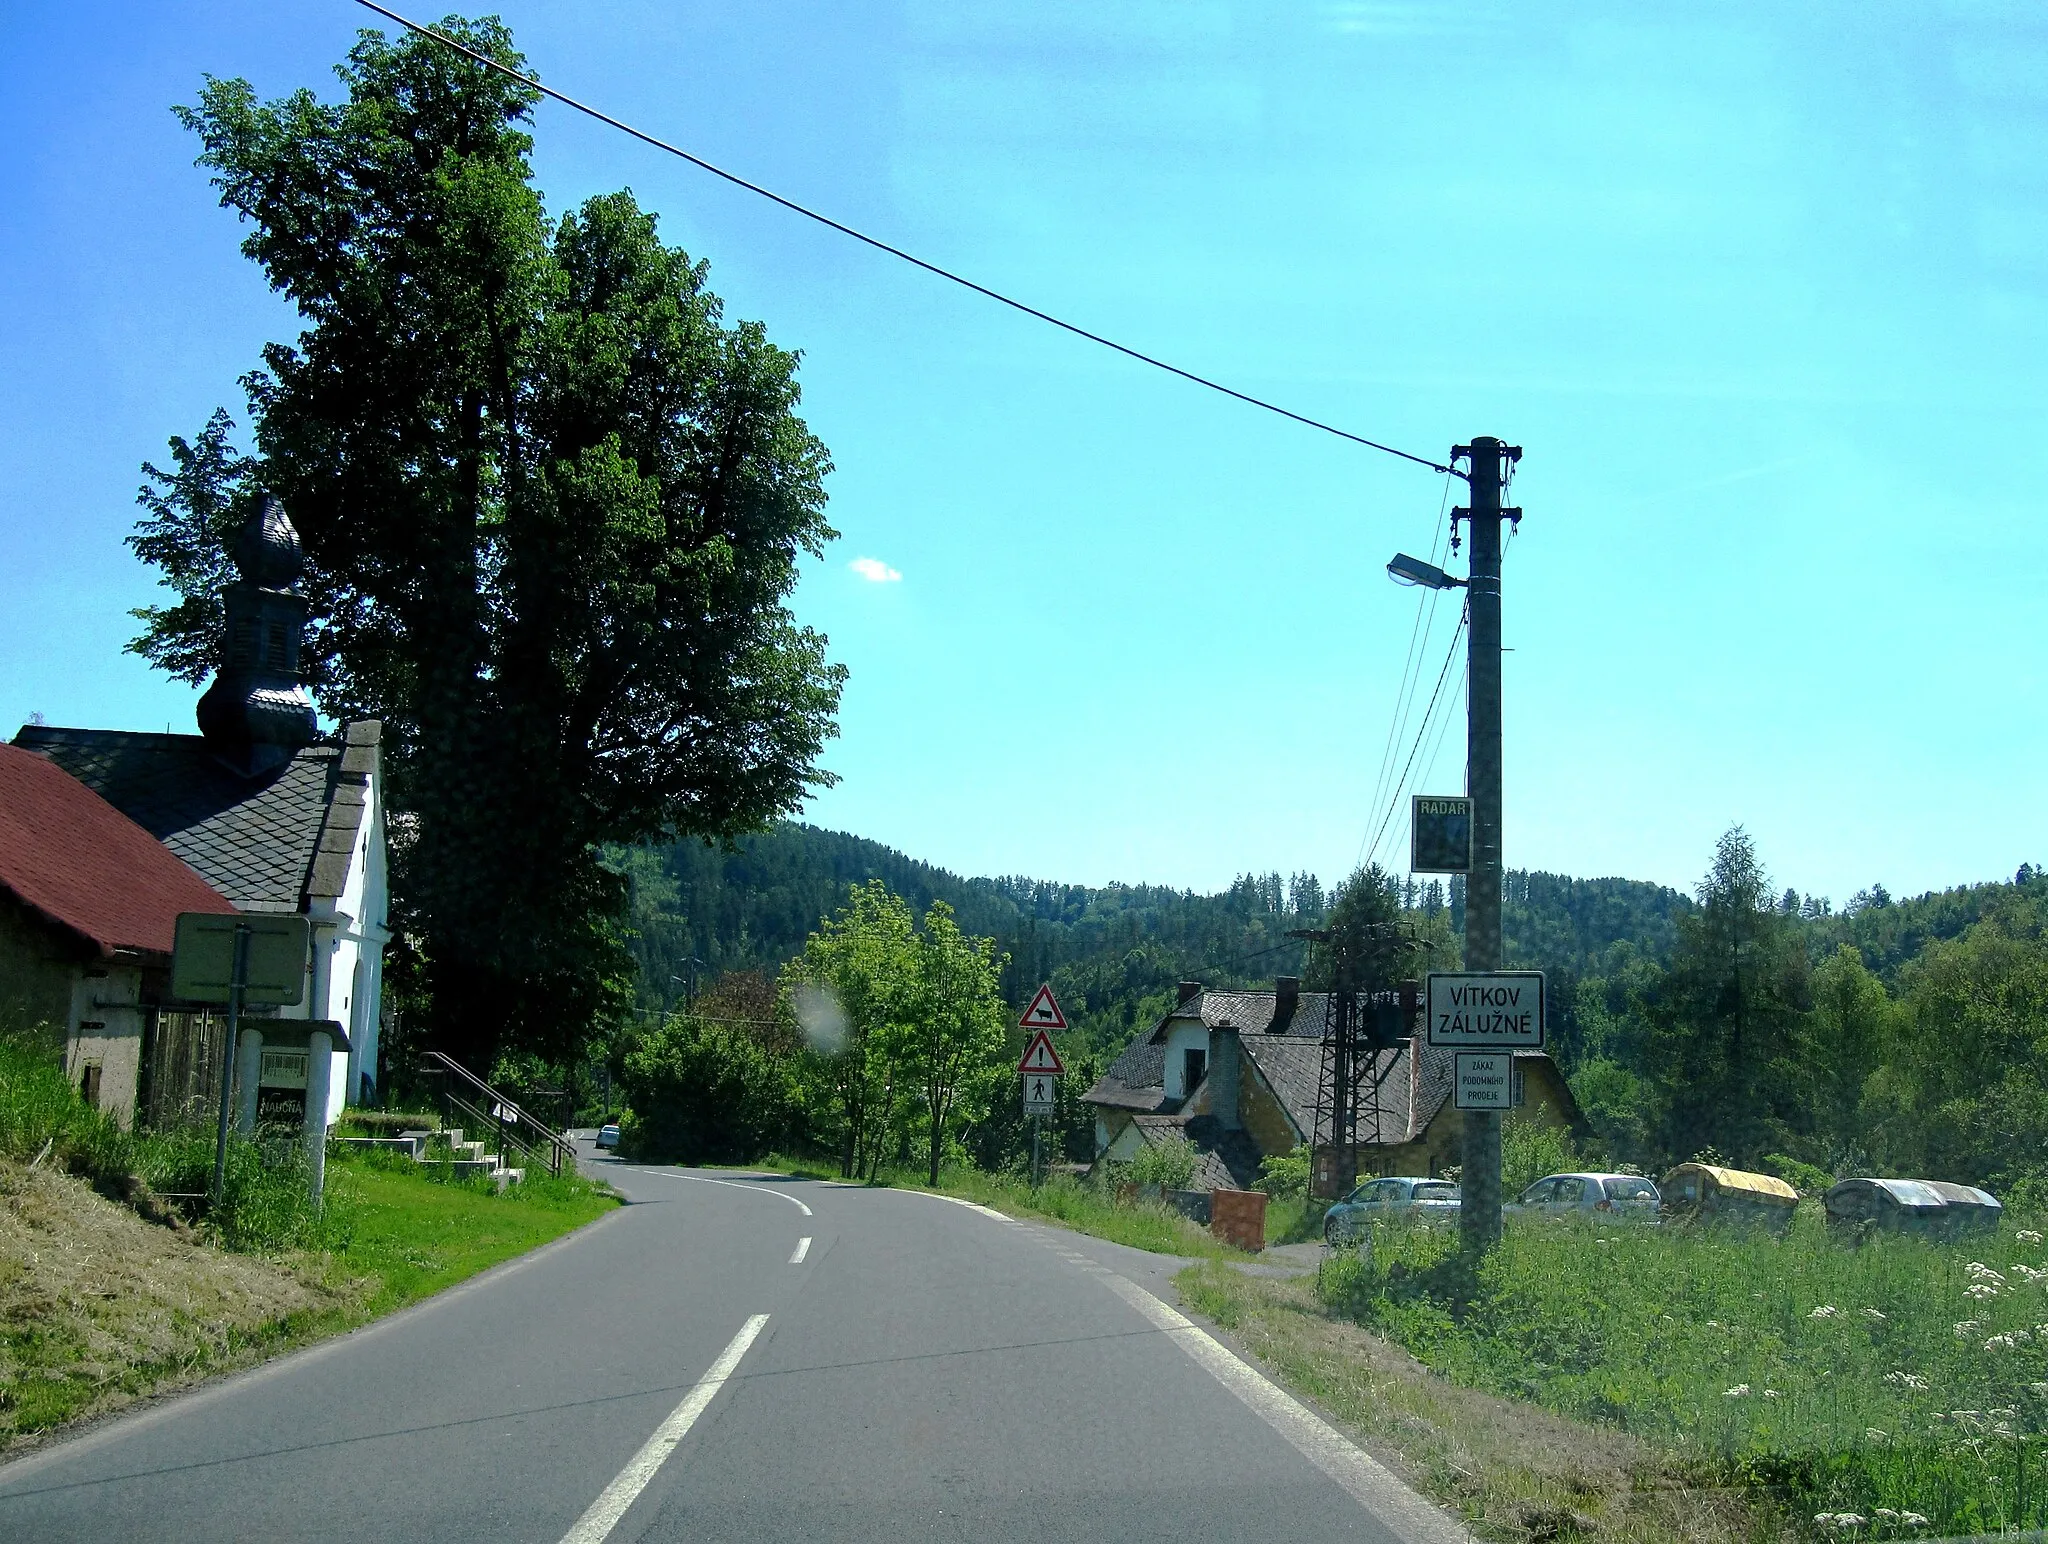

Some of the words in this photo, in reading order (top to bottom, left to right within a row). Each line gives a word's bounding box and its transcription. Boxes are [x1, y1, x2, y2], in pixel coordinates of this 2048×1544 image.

[1421, 801, 1466, 815] RADAR
[1450, 983, 1521, 1007] VÍTKOV
[1439, 1010, 1532, 1034] ZÁLUŽNÉ
[1472, 1060, 1494, 1071] ZÁKAZ
[1462, 1075, 1504, 1085] PODOMNÍHO
[1467, 1091, 1499, 1100] PRODEJE
